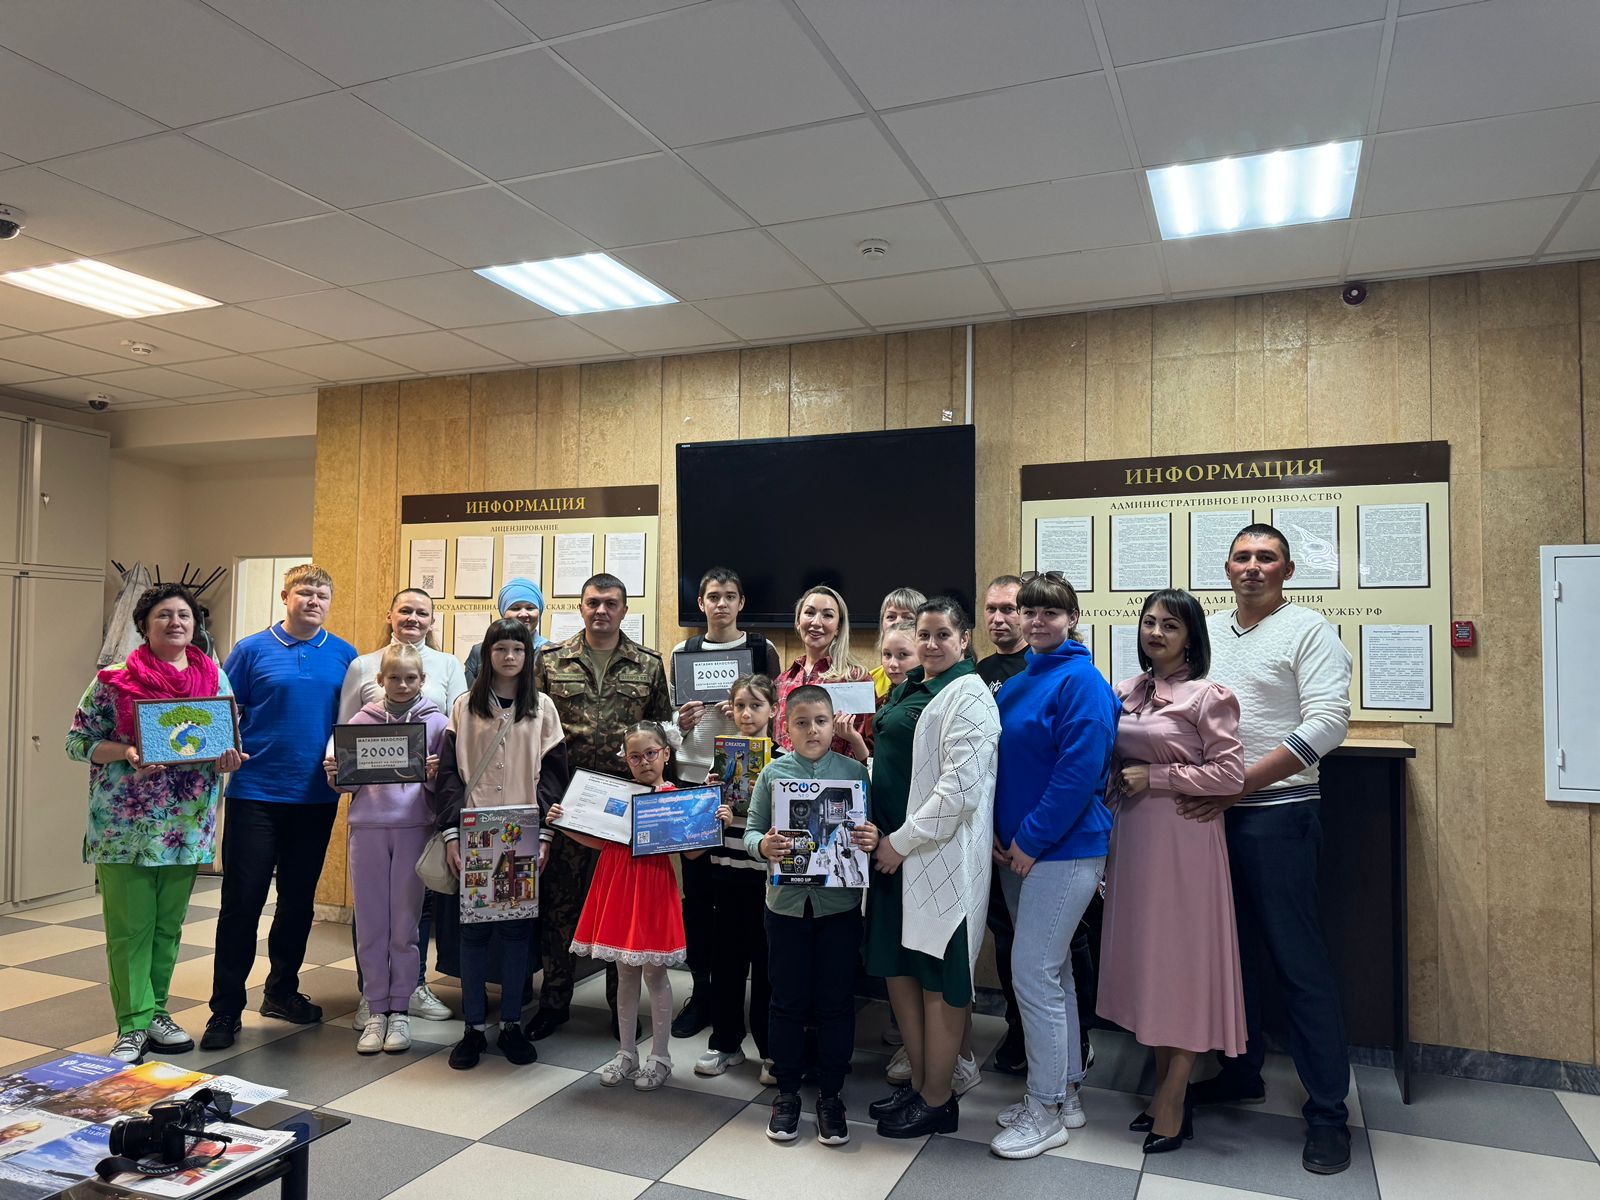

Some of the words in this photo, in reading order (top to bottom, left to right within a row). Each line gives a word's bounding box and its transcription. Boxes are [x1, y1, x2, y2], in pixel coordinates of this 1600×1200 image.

[1125, 459, 1324, 485] ИНФОРМАЦИЯ
[466, 497, 586, 514] ИНФОРМАЦИЯ
[1110, 497, 1239, 510] АДМИНИСТРАТИВНОЕ
[1241, 492, 1343, 504] ПРОИЗВОДСТВО
[490, 524, 559, 533] ЛИЦЕНЗИРОВАНИЕ
[1203, 596, 1227, 605] ДЛЯ
[433, 604, 500, 612] ГОСУДАРСТВЕННА
[1366, 607, 1384, 617] РФ
[697, 669, 736, 680] 20000
[360, 746, 405, 758] 20000
[779, 782, 820, 793] YCOO
[137, 1164, 180, 1174] Canon
